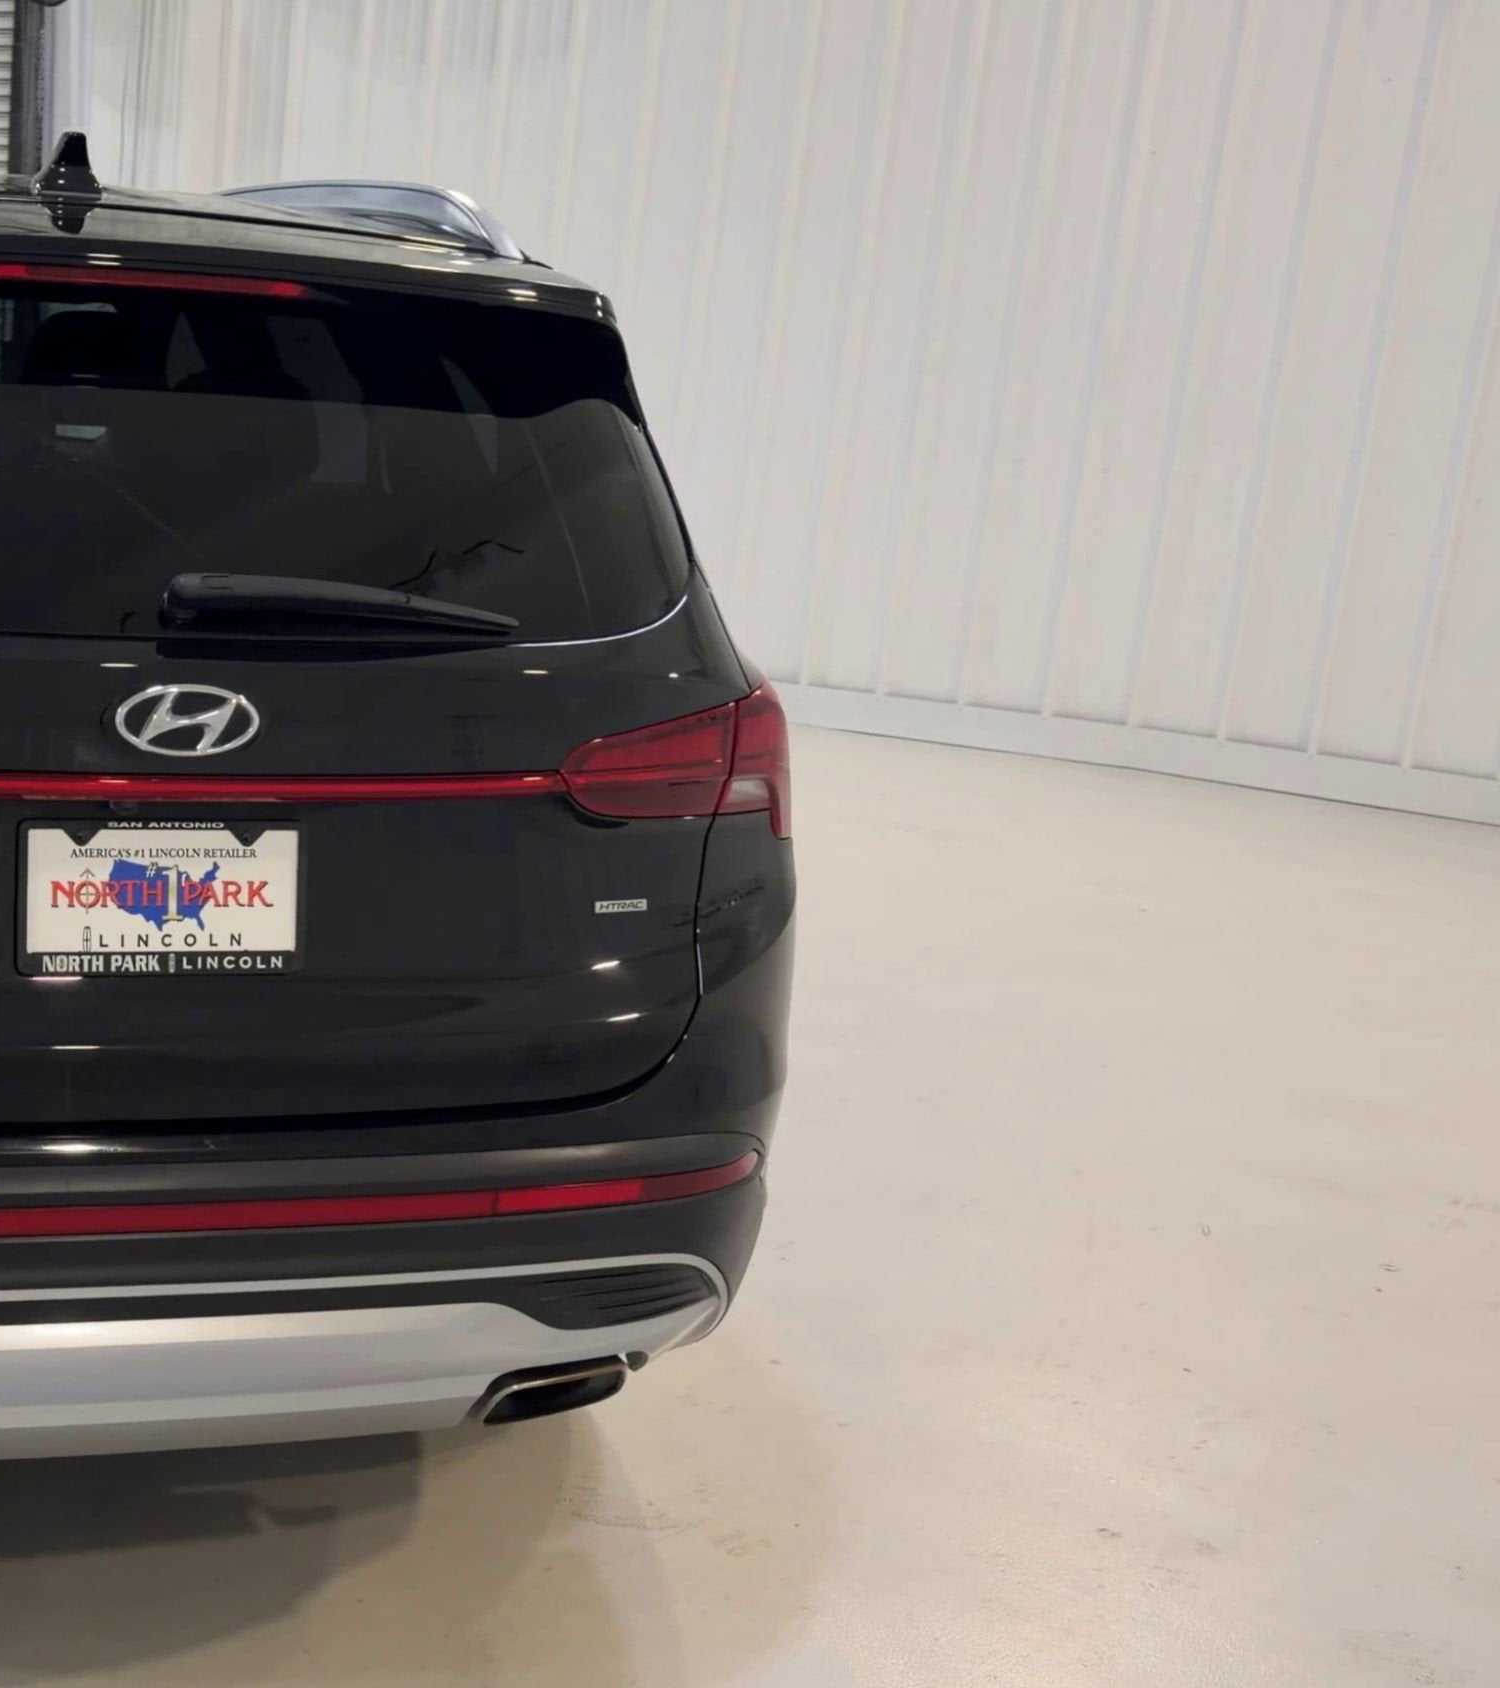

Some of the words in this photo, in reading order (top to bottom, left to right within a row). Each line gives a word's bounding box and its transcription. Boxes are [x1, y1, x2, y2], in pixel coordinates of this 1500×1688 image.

[107, 821, 140, 829] SAN
[147, 821, 225, 830] ANTONIO
[70, 847, 132, 858] AMERICA'S
[134, 848, 146, 858] #1
[149, 848, 201, 858] LINCOLN
[204, 848, 257, 859] RETAILER
[50, 880, 165, 908] NORTH
[182, 880, 274, 909] PARK
[599, 901, 645, 912] HTRAC
[99, 932, 243, 948] LINCOLN
[42, 954, 104, 973] NORTH
[110, 954, 161, 973] PARK
[182, 955, 284, 971] LINCOLN
